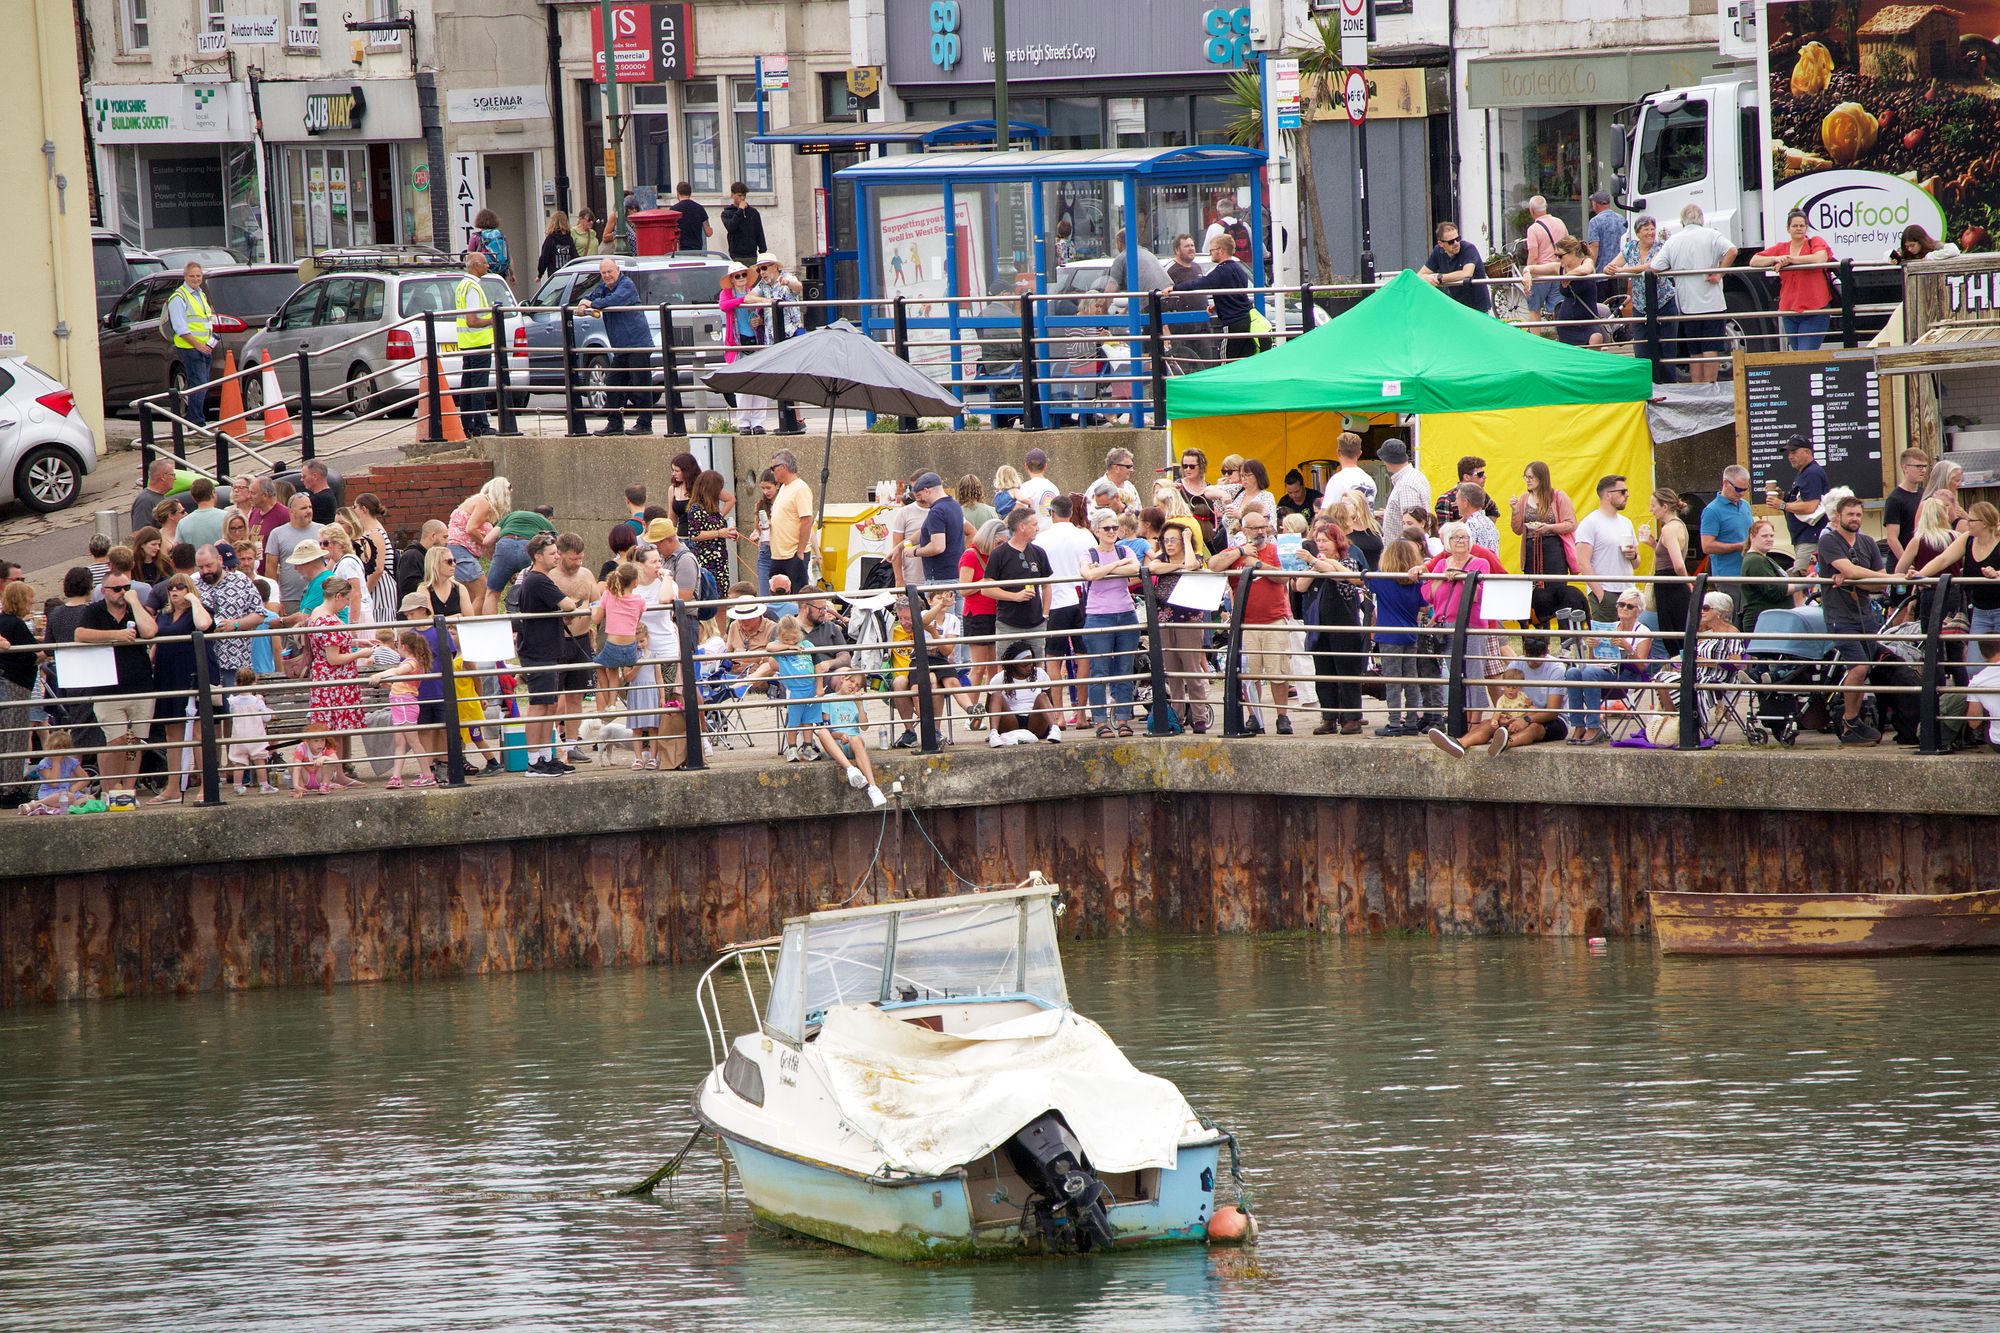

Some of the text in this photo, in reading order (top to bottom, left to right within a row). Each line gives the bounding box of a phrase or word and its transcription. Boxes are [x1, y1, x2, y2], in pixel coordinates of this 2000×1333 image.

[231, 23, 274, 36] Aviator House
[1343, 19, 1364, 31] ZONE
[200, 35, 226, 50] TATTOO
[660, 17, 676, 68] SOLD
[982, 42, 1096, 66] Weme to High Street's Co-op
[110, 100, 147, 113] YORKSHIRE
[473, 96, 522, 108] SOLEMAR
[305, 96, 356, 130] SUBWAY
[112, 116, 142, 130] BUILDING
[142, 116, 168, 130] SOCIETY
[196, 120, 216, 128] agency
[456, 156, 475, 254] TATT
[1820, 198, 1909, 230] Bidfood
[882, 219, 925, 234] Supporting
[926, 217, 940, 226] you
[888, 234, 904, 243] well
[914, 228, 934, 237] West
[1834, 231, 1876, 246] Inspired
[1877, 230, 1889, 243] by
